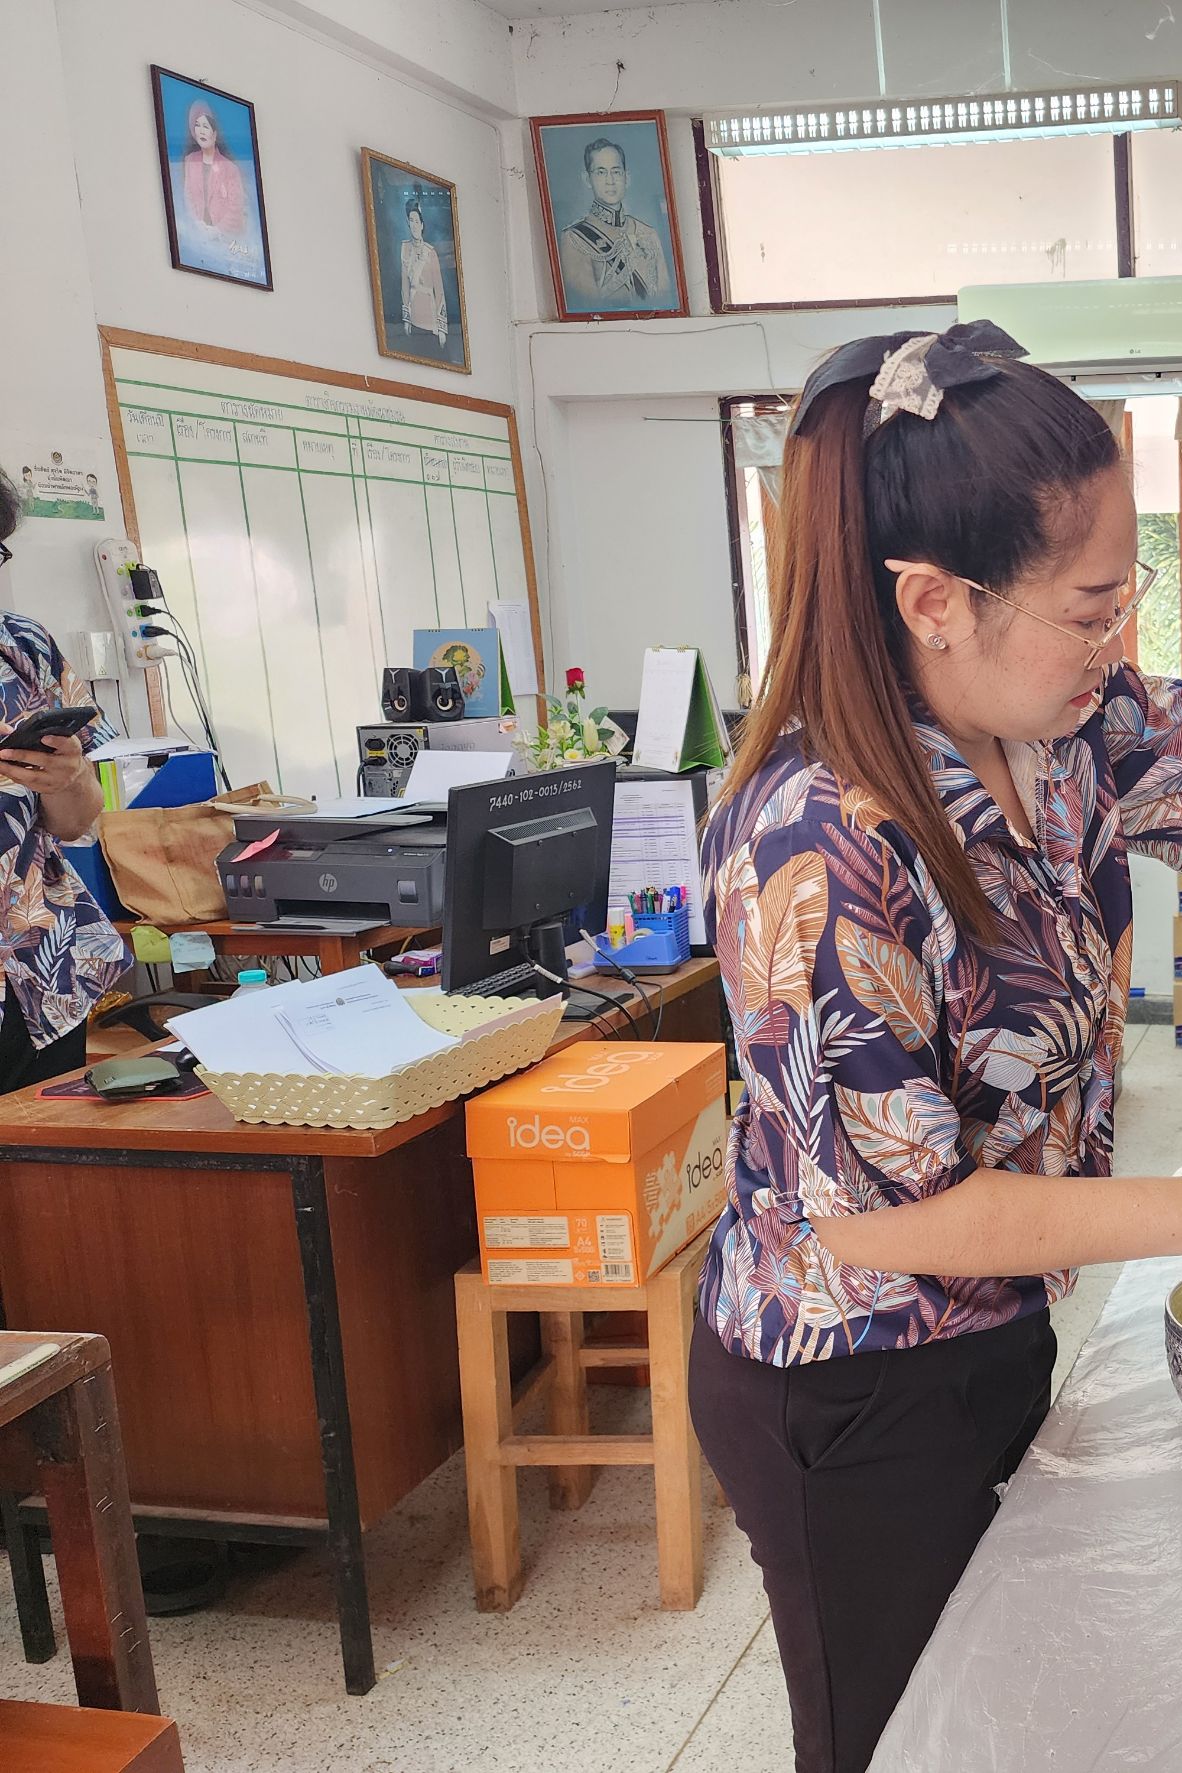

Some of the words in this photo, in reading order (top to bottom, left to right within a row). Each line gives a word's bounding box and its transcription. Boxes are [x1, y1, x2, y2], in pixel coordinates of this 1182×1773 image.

[540, 1051, 657, 1093] idea
[506, 1114, 591, 1150] idea
[686, 1147, 723, 1194] idea
